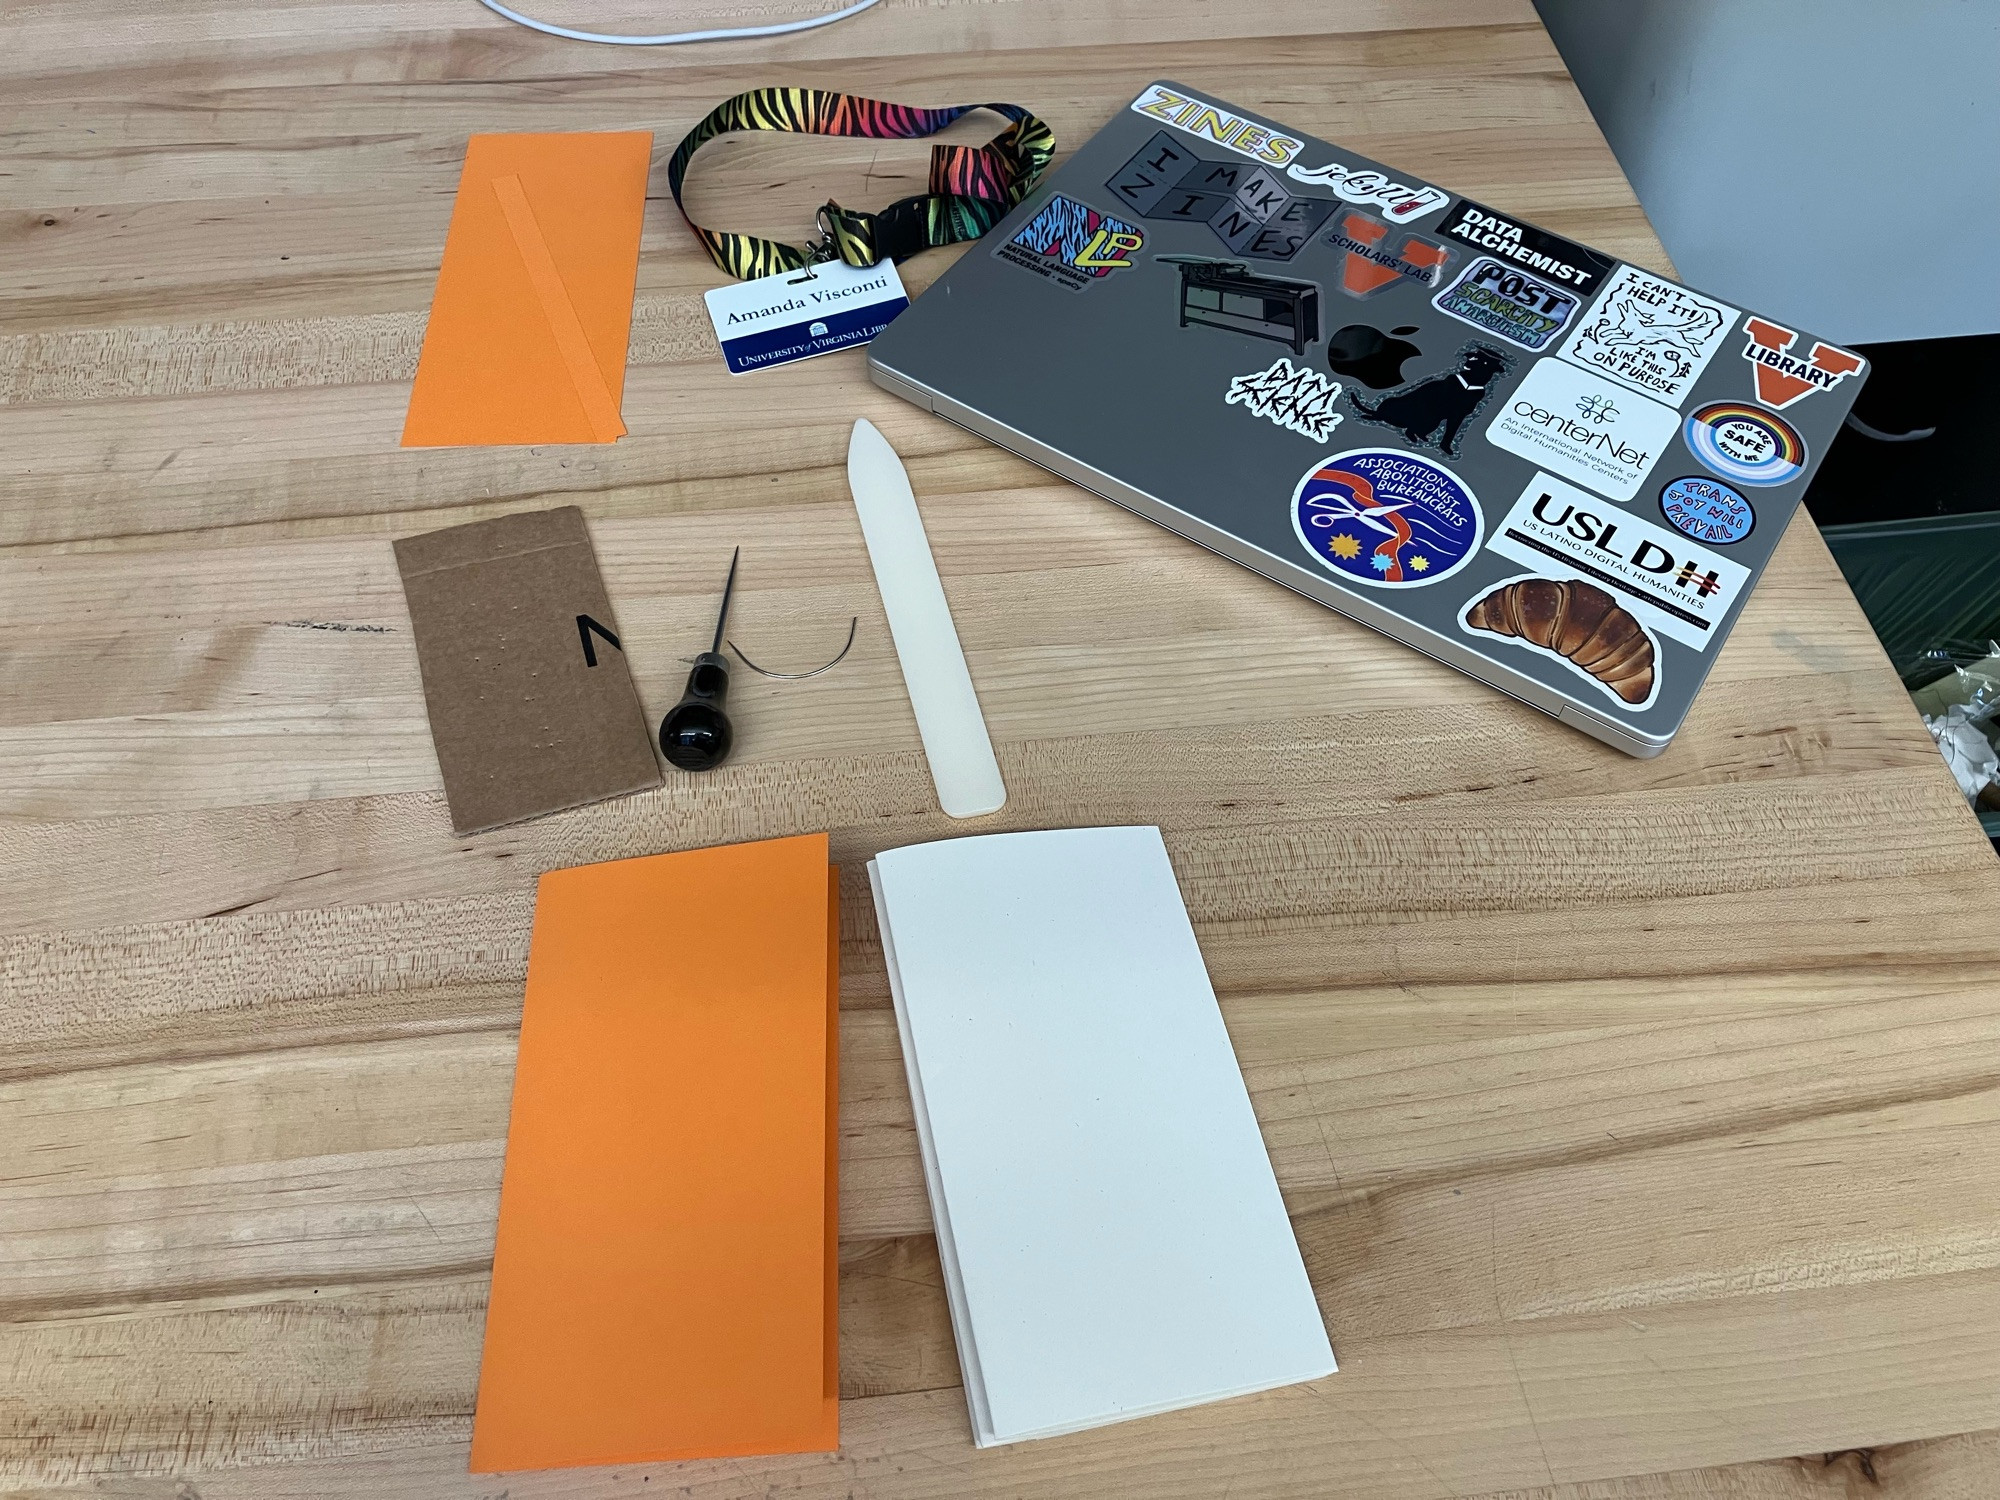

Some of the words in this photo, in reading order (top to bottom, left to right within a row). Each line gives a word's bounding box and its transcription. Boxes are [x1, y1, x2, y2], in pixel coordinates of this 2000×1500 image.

[1138, 88, 1298, 164] ZINES
[1148, 147, 1179, 172] I
[1205, 167, 1310, 222] MAKE
[1462, 208, 1524, 243] DATA
[997, 250, 1051, 277] PROCESSING
[1004, 243, 1041, 264] NATURAL
[1043, 258, 1090, 284] LANGUAGE
[1329, 234, 1402, 268] SCHOLARS'
[1404, 265, 1433, 282] LAB
[1451, 223, 1592, 285] ALCHEMIST
[727, 299, 806, 325] Amanda
[809, 276, 888, 304] Visconti
[1472, 263, 1571, 314] POST
[1626, 273, 1640, 283] I
[1642, 282, 1686, 301] CAN'T
[1627, 286, 1667, 307] HELP
[1668, 304, 1698, 320] IT!
[738, 344, 805, 367] UNIVERSITY
[812, 331, 863, 350] VIRGINIA
[1610, 347, 1638, 363] LIKE
[1642, 360, 1667, 375] THIS
[1635, 347, 1657, 360] I'M
[1745, 344, 1837, 388] LIBRARY
[1593, 352, 1617, 367] ON
[1618, 362, 1681, 395] PURPOSE
[1501, 422, 1532, 441] Digital
[1534, 436, 1589, 467] Humanities
[1591, 464, 1629, 485] Centers
[1505, 417, 1519, 426] An
[1520, 424, 1581, 455] International
[1583, 452, 1625, 474] Network
[1626, 472, 1638, 481] of
[1514, 401, 1649, 470] centerNet
[1719, 441, 1741, 460] WITH
[1744, 454, 1760, 462] ME
[1724, 429, 1766, 454] SAFE
[1731, 422, 1754, 432] YOU
[1754, 429, 1772, 446] ARE
[1353, 458, 1448, 488] ASSOCIATION
[1369, 468, 1461, 508] ABOLITIONIST
[1377, 480, 1467, 527] BUREAUCRATS
[1669, 490, 1706, 510] JOY
[1708, 506, 1744, 529] WILL
[1683, 482, 1746, 514] TRANS
[1667, 504, 1733, 539] PREVAIL
[1523, 519, 1538, 531] US
[1540, 528, 1582, 551] LATINO
[1584, 548, 1629, 575] DIGITAL
[1632, 571, 1705, 610] HUMANITIES
